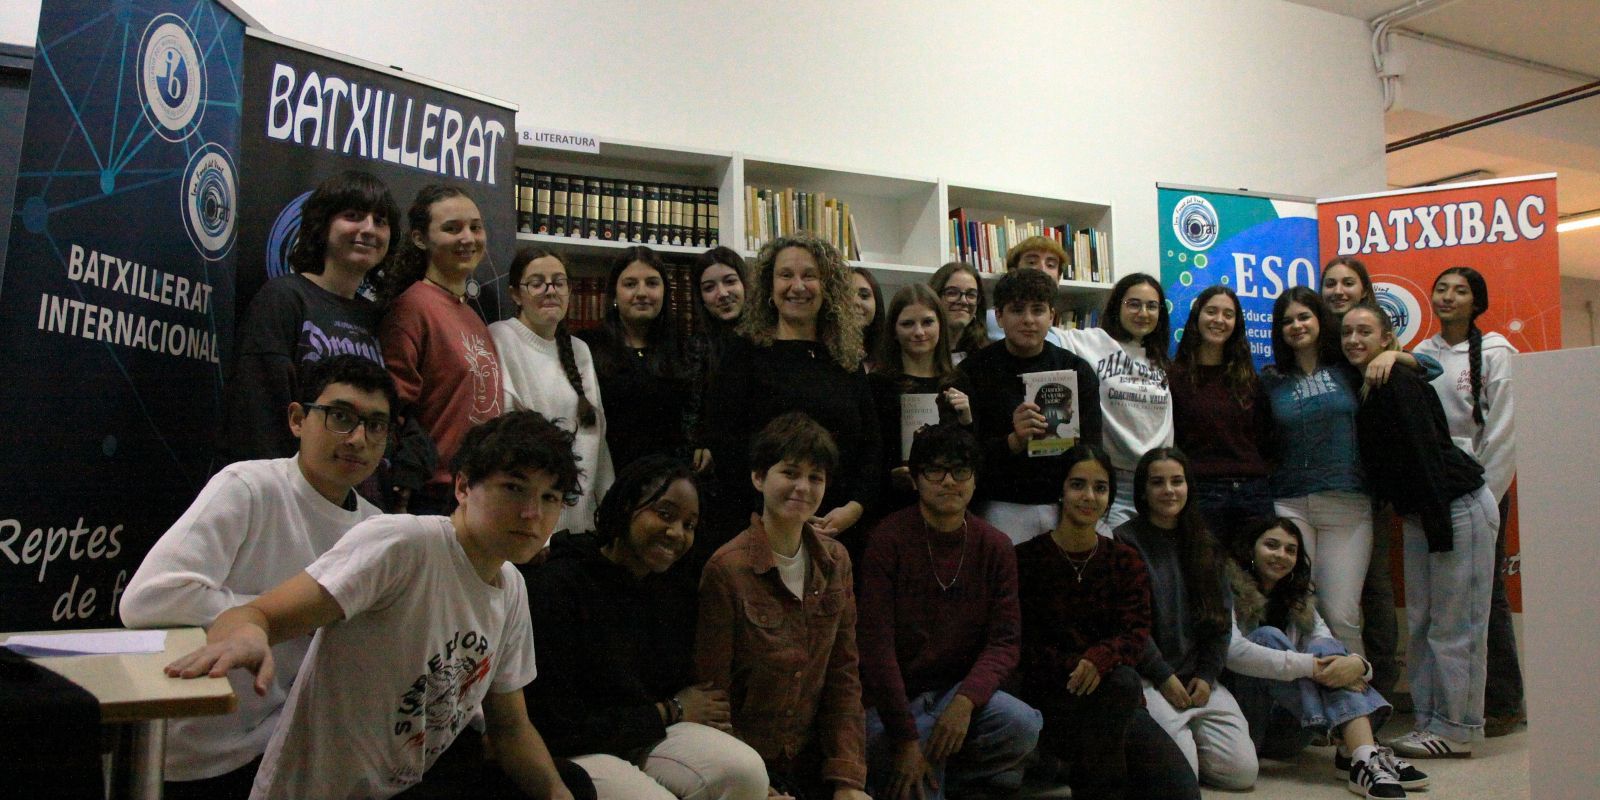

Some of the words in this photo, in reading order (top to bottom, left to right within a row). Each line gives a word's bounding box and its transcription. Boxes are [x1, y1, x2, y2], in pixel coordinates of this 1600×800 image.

[267, 63, 505, 185] BATXILLERAT
[523, 131, 533, 141] 8.
[535, 132, 595, 147] LITERATURA
[1336, 195, 1545, 256] BATXIBAC
[67, 244, 213, 315] BATXILLERAT
[1232, 252, 1315, 300] ESO
[38, 293, 220, 364] INTERNACIONAL
[1097, 350, 1133, 381] PALM
[1108, 387, 1147, 403] COACHELLA
[0, 517, 124, 583] Reptes
[52, 574, 97, 622] de
[110, 569, 126, 616] f
